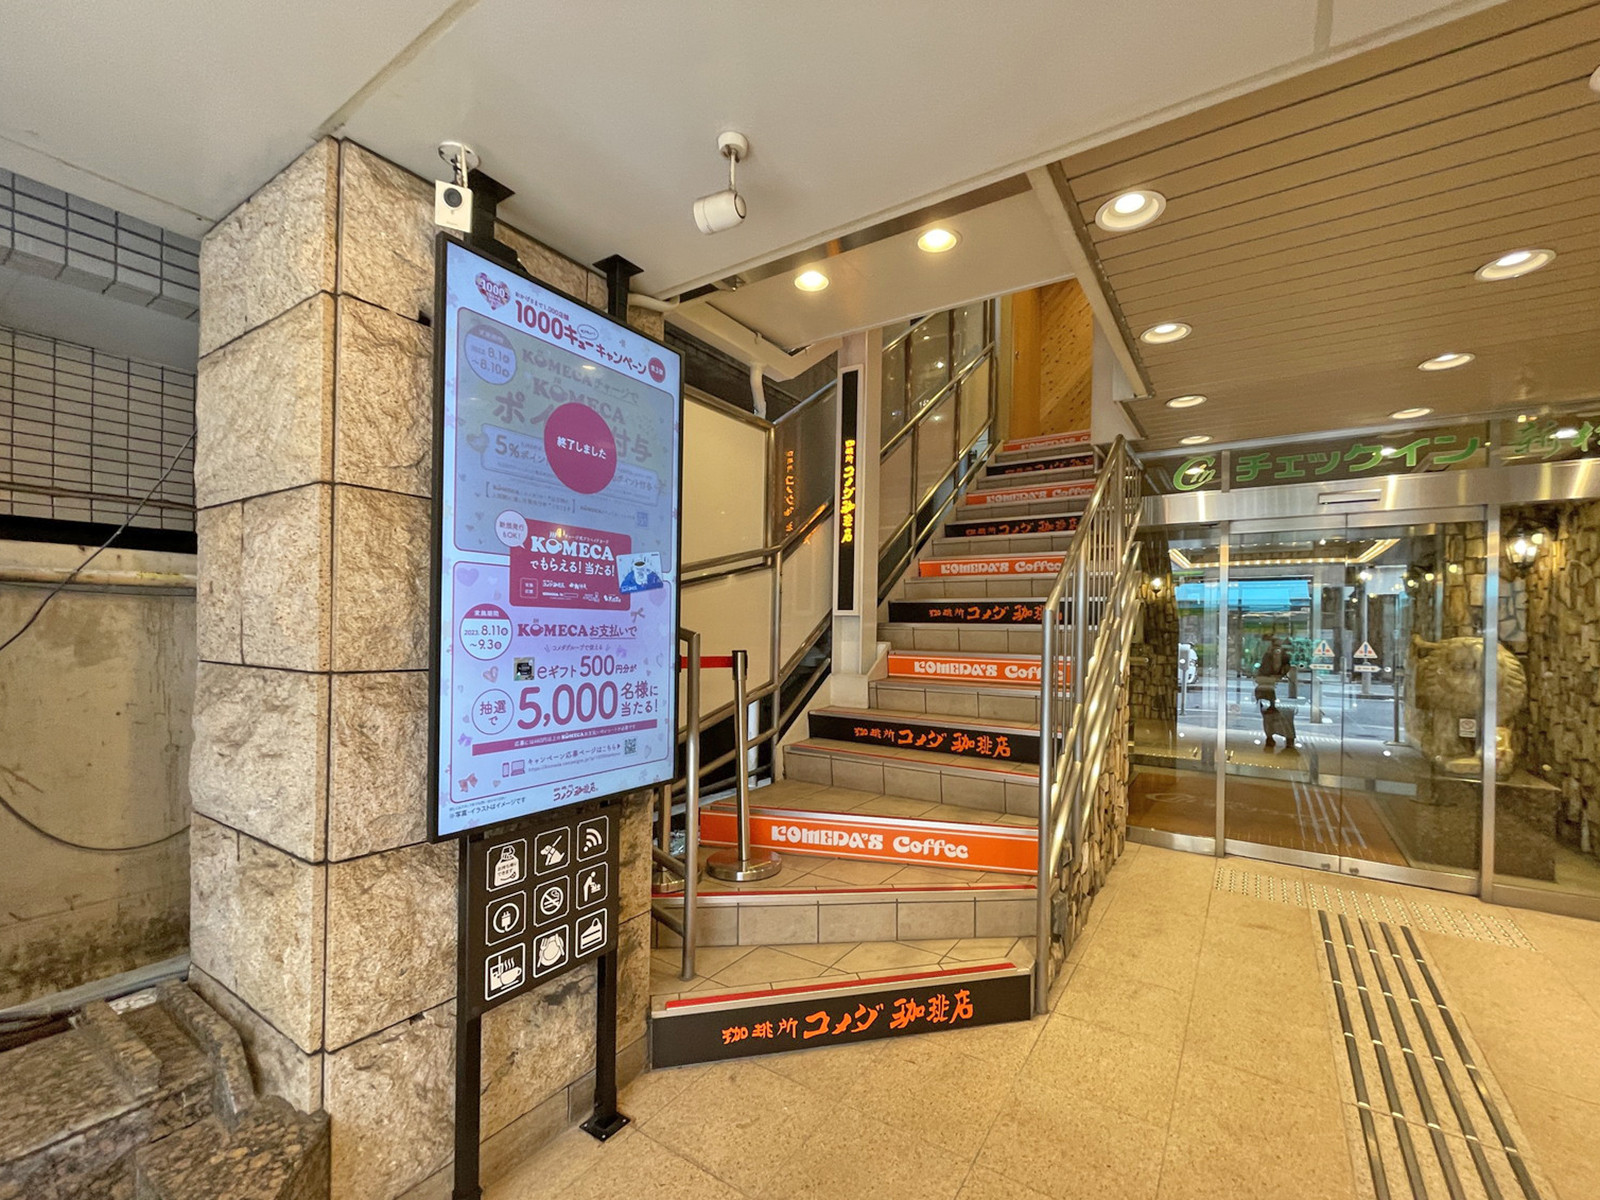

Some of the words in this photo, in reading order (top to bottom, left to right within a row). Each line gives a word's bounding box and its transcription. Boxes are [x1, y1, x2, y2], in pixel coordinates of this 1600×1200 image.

[556, 436, 607, 460] 終了しました
[987, 490, 1047, 503] KOMEDA'S
[531, 534, 615, 561] KOMECA
[941, 562, 1009, 574] KOMEDA'S
[914, 660, 998, 677] KOMEDA'S
[620, 681, 659, 700] 名様に
[479, 699, 507, 716] 抽選
[517, 681, 618, 730] 5,000
[771, 825, 884, 850] KOMEDA'S
[893, 835, 969, 859] Coffee
